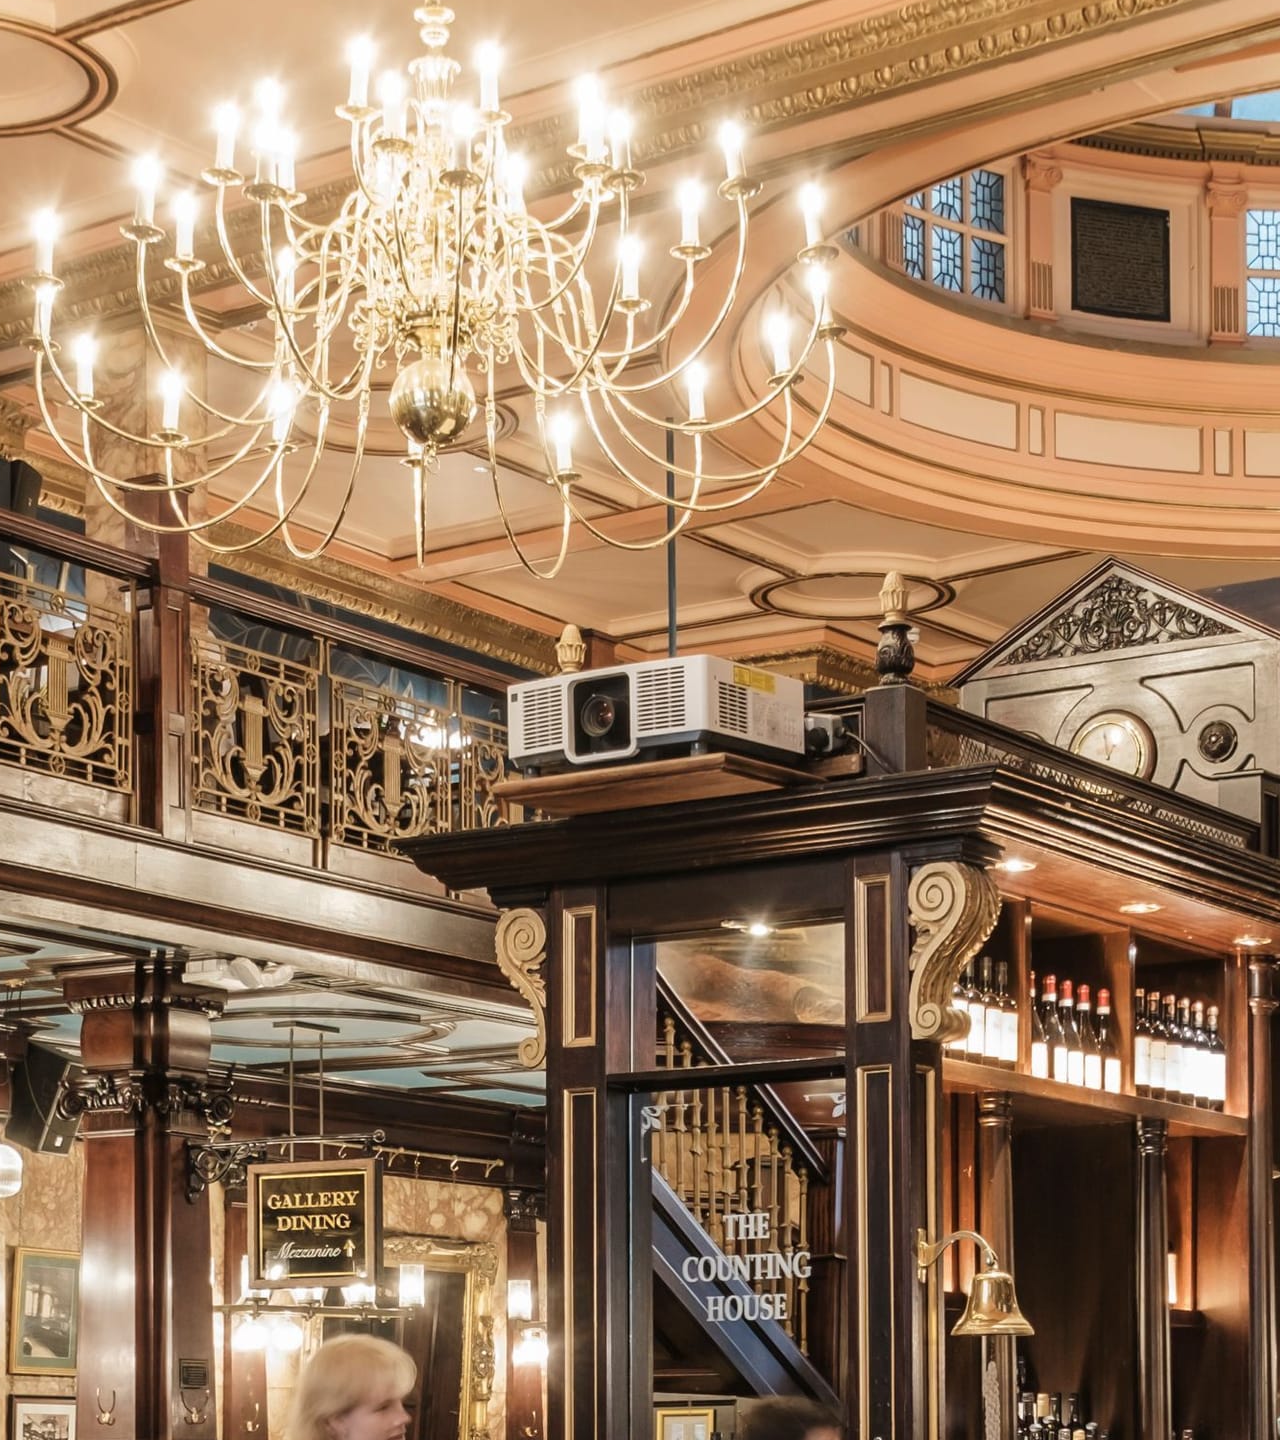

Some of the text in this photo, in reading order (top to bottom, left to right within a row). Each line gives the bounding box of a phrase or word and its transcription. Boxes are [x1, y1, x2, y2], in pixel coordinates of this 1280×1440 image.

[267, 1190, 360, 1210] GALLERY
[277, 1213, 351, 1232] DINING
[723, 1213, 770, 1240] THE
[274, 1242, 342, 1259] Mezzanine
[682, 1251, 812, 1282] COUNTING
[706, 1293, 788, 1322] HOUSE
